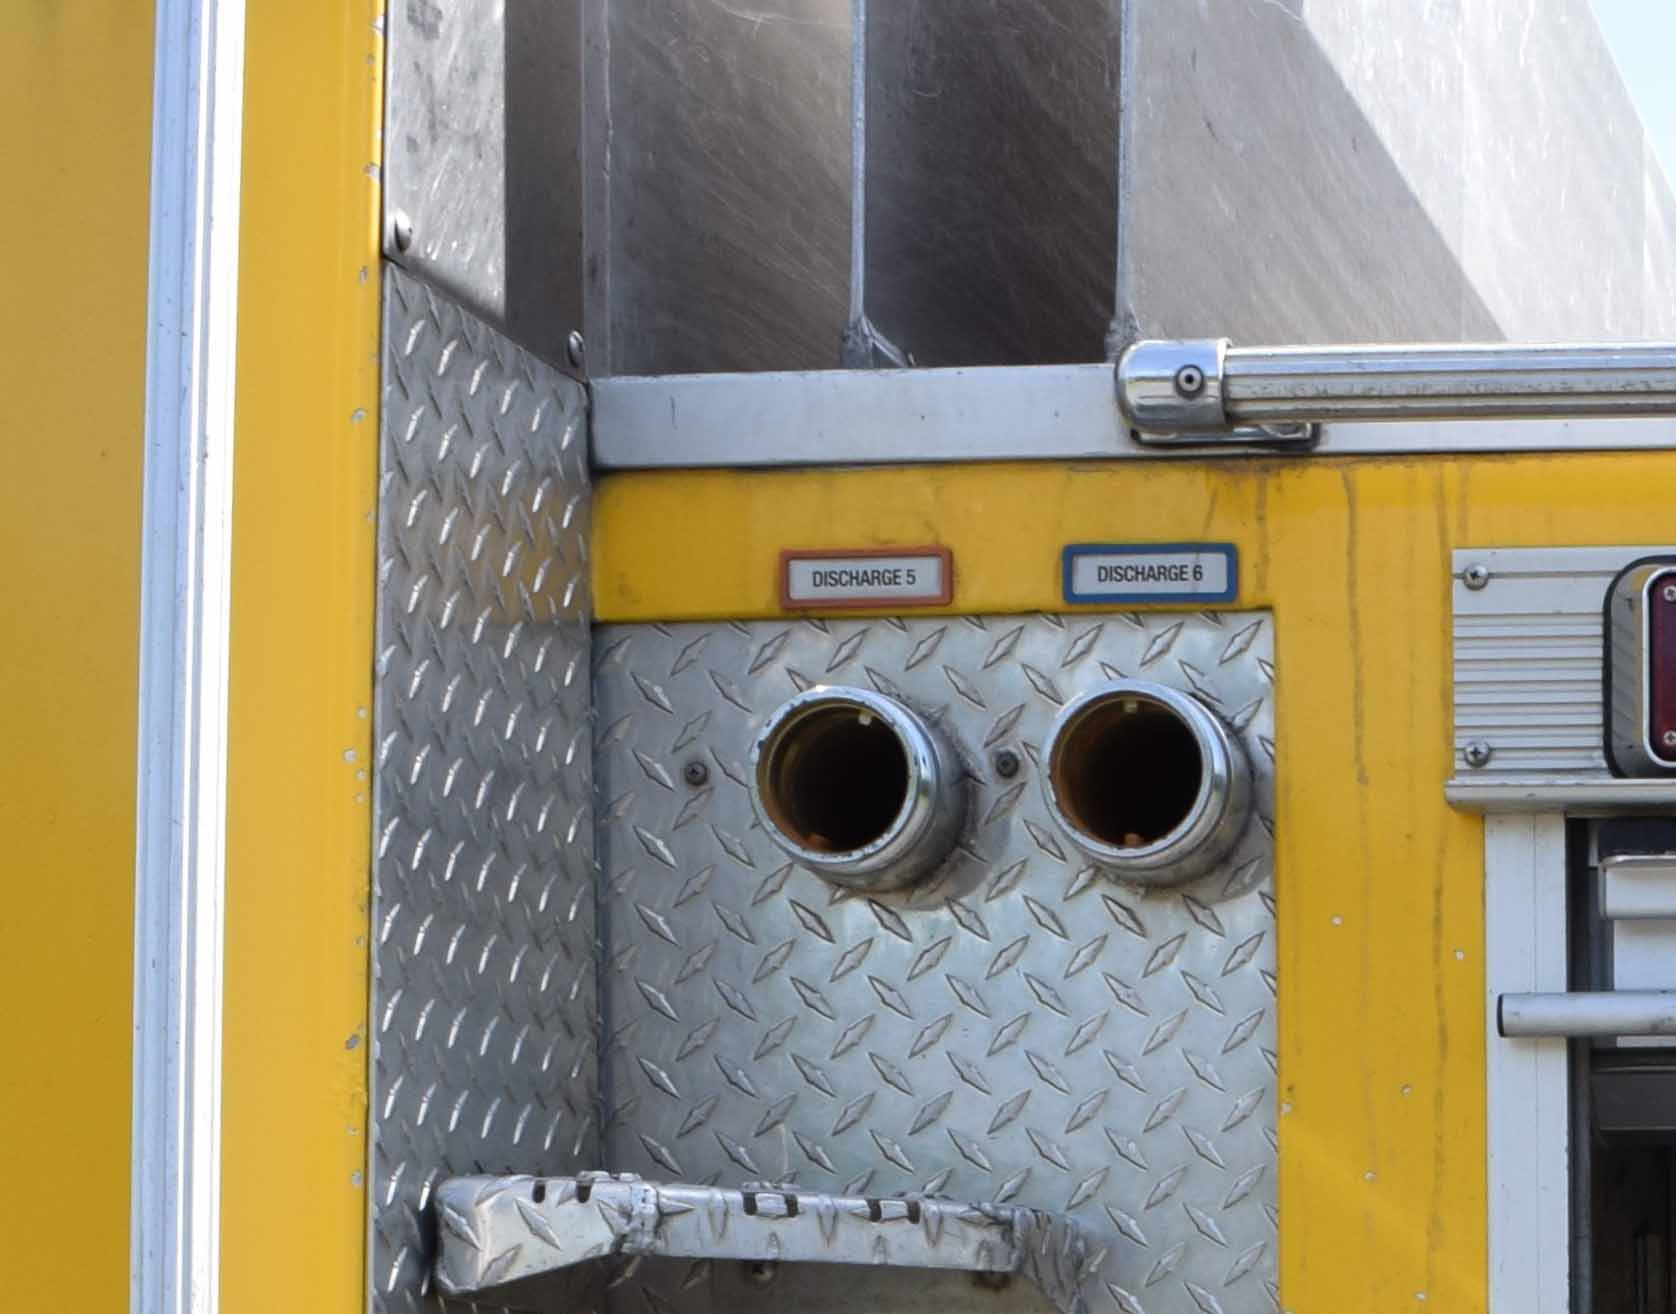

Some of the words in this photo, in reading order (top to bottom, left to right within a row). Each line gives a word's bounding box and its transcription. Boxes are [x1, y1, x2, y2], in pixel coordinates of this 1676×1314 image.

[812, 569, 904, 588] DISCHARGE
[905, 568, 917, 586] 5
[1097, 564, 1190, 583] DISCHARGE
[1191, 564, 1204, 583] 6
